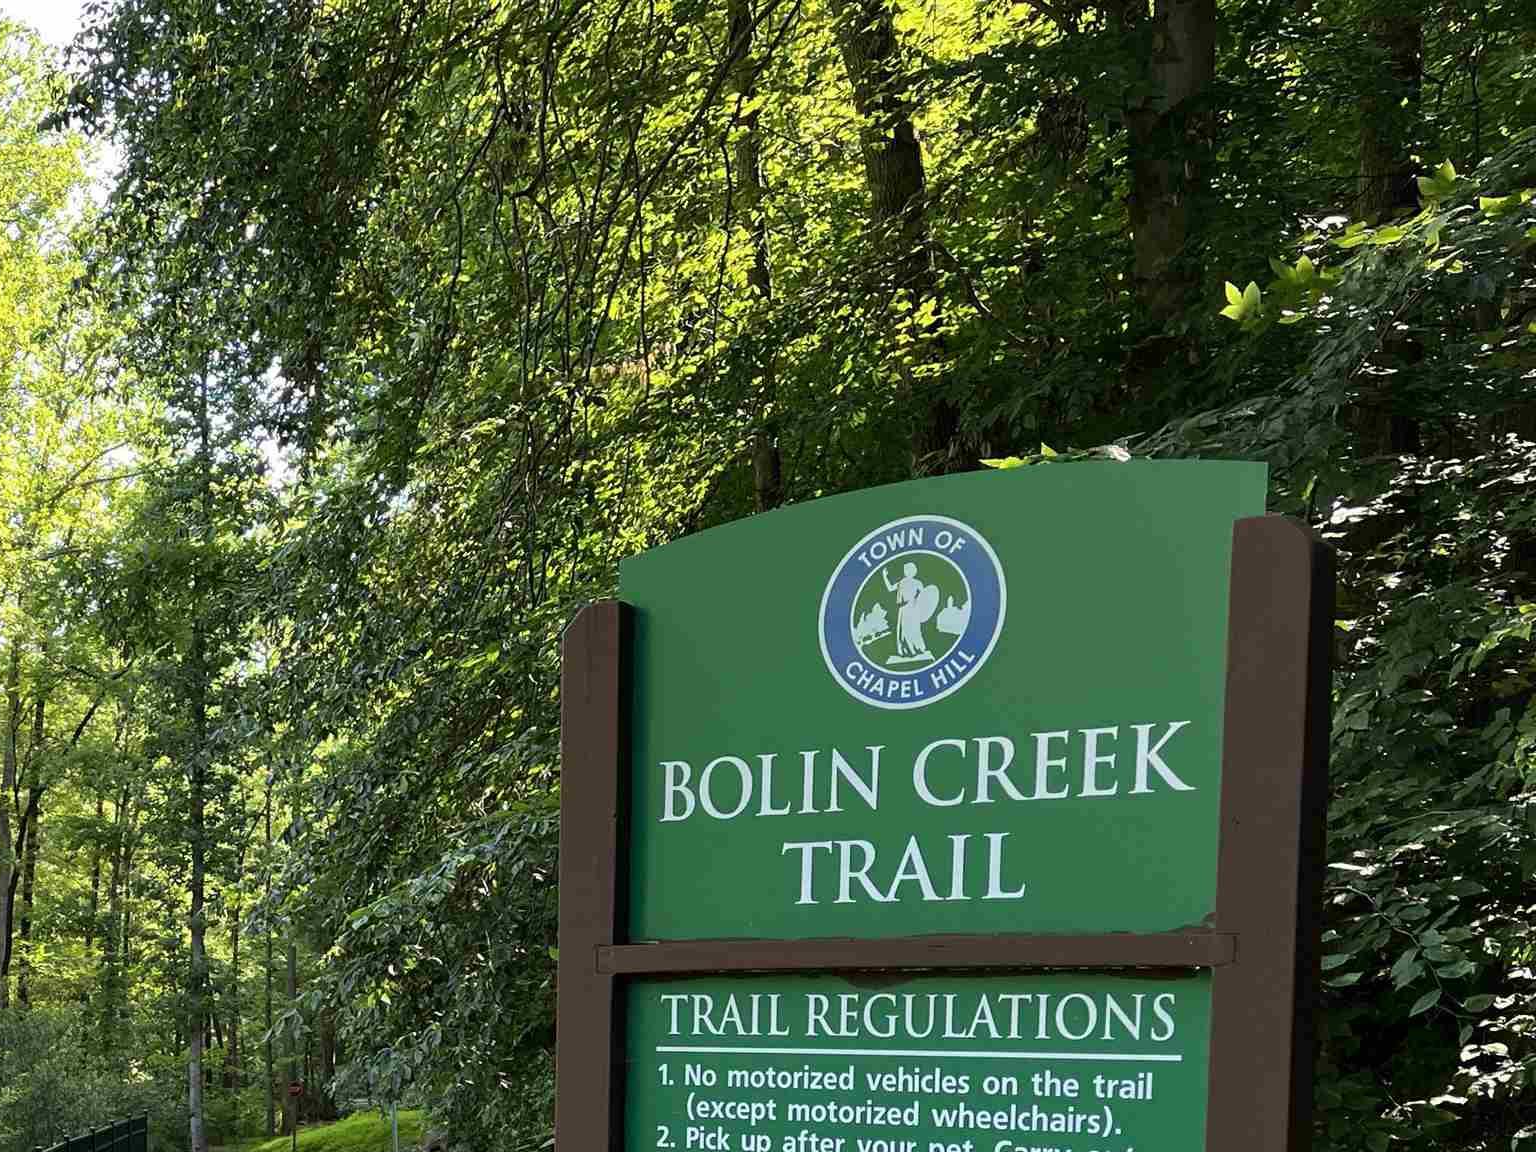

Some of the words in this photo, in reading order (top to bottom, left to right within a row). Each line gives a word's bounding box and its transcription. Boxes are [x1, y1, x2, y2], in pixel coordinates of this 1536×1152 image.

[858, 527, 923, 567] TOWN
[935, 531, 966, 553] OF
[845, 662, 923, 698] CHAPEL
[931, 650, 975, 689] HILL
[659, 745, 886, 822] BOLIN
[912, 720, 1197, 807] CREEK
[781, 832, 1026, 905] TRAIL
[660, 993, 790, 1036] TRAIL
[805, 993, 1175, 1042] REGULATIONS
[658, 1063, 674, 1086] 1.
[684, 1063, 717, 1087] No
[727, 1064, 855, 1091] motorized
[865, 1066, 970, 1094] vehicles
[982, 1075, 1018, 1096] on
[1031, 1069, 1080, 1098] the
[1092, 1071, 1153, 1100] trail
[656, 1125, 676, 1148] 2.
[686, 1125, 731, 1151] Pick
[686, 1092, 777, 1127] (except
[787, 1099, 920, 1126] motorized
[931, 1101, 1122, 1138] wheelchairs).
